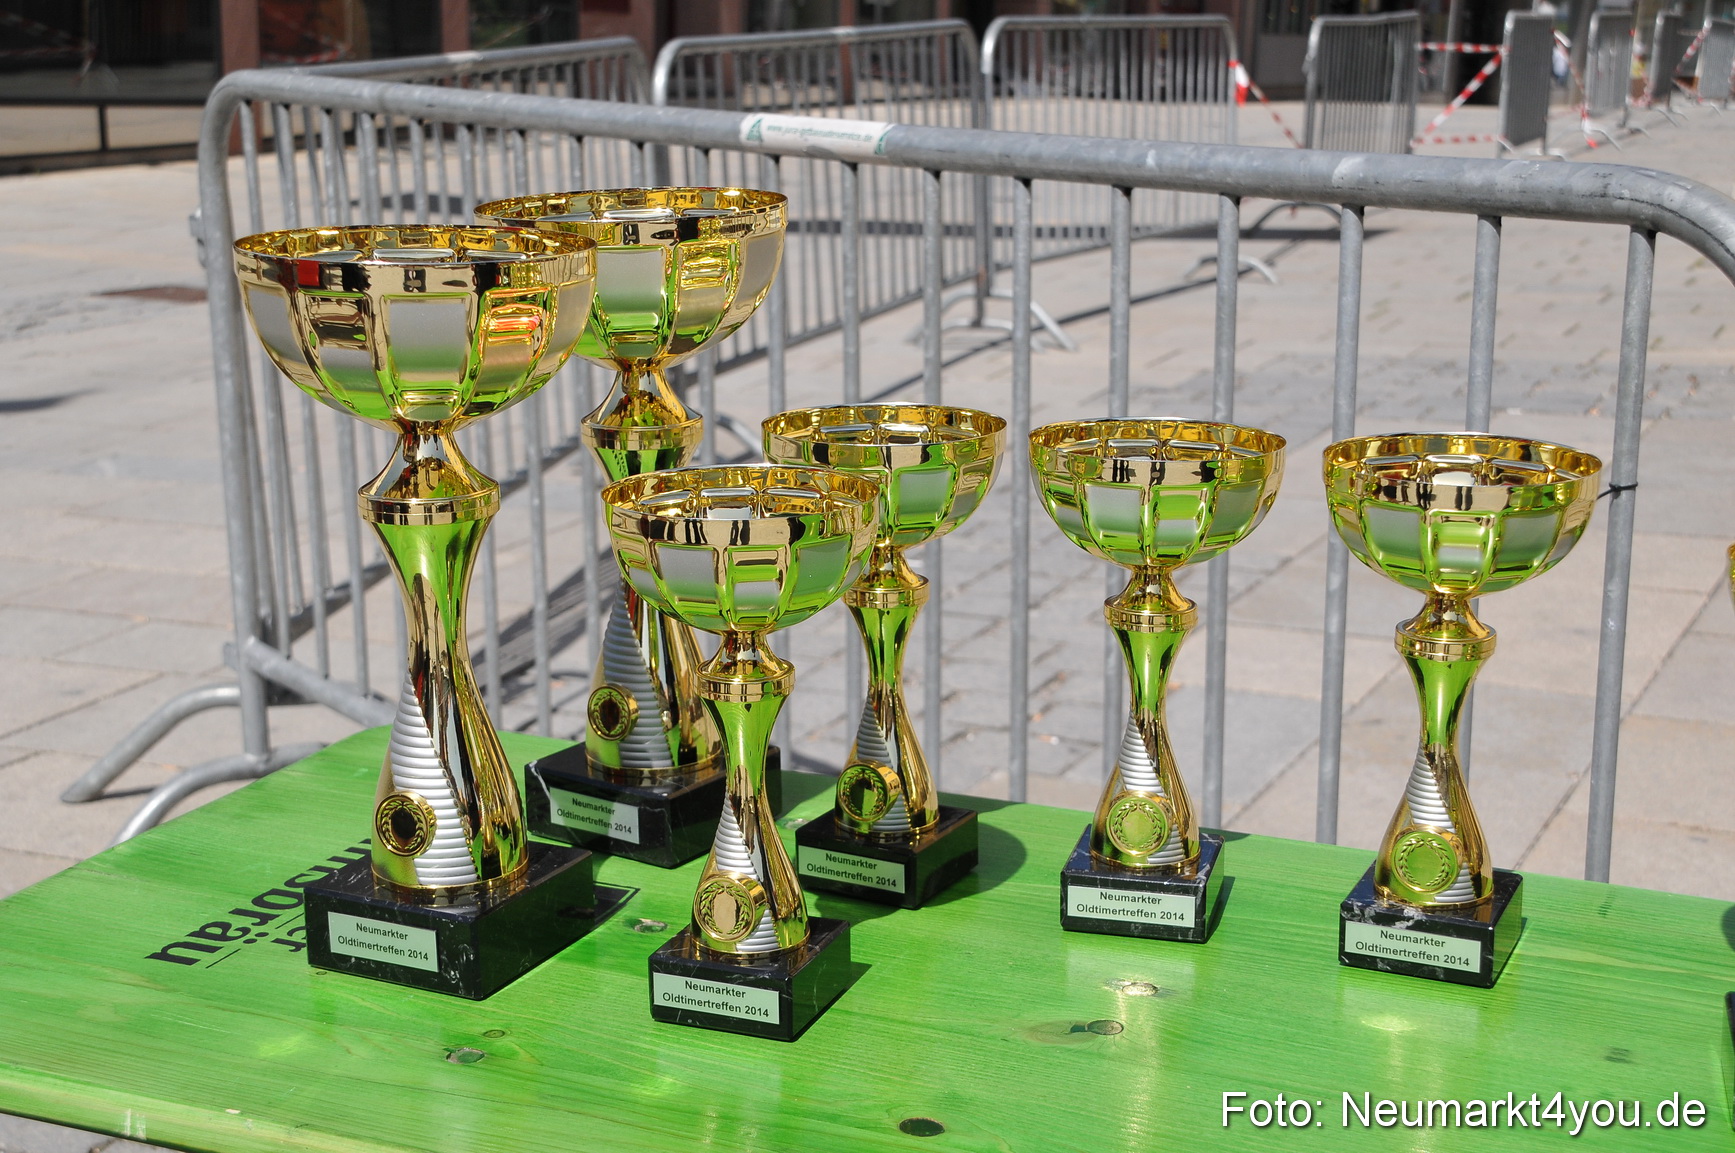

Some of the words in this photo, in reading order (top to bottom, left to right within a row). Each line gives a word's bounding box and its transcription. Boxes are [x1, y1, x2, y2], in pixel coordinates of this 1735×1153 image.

[572, 797, 615, 815] Neumarkter
[557, 808, 613, 829] Oldtimertreffen
[614, 822, 632, 834] 2014
[825, 852, 877, 870] Neumarkter
[806, 863, 873, 883] Oldtimertreffen
[875, 875, 897, 888] 2014
[1100, 891, 1162, 905] Neumarkter
[1076, 903, 1157, 919] Oldtimertreffen
[1159, 910, 1185, 921] 2014
[355, 922, 409, 940] Neumarkter
[1380, 929, 1446, 948] Neumarkter
[337, 935, 406, 957] Oldtimertreffen
[407, 948, 429, 961] 2014
[1355, 941, 1440, 962] Oldtimertreffen
[1443, 954, 1470, 967] 2014
[684, 980, 746, 999] Neumarkter
[662, 992, 742, 1013] Oldtimertreffen
[744, 1004, 770, 1018] 2014
